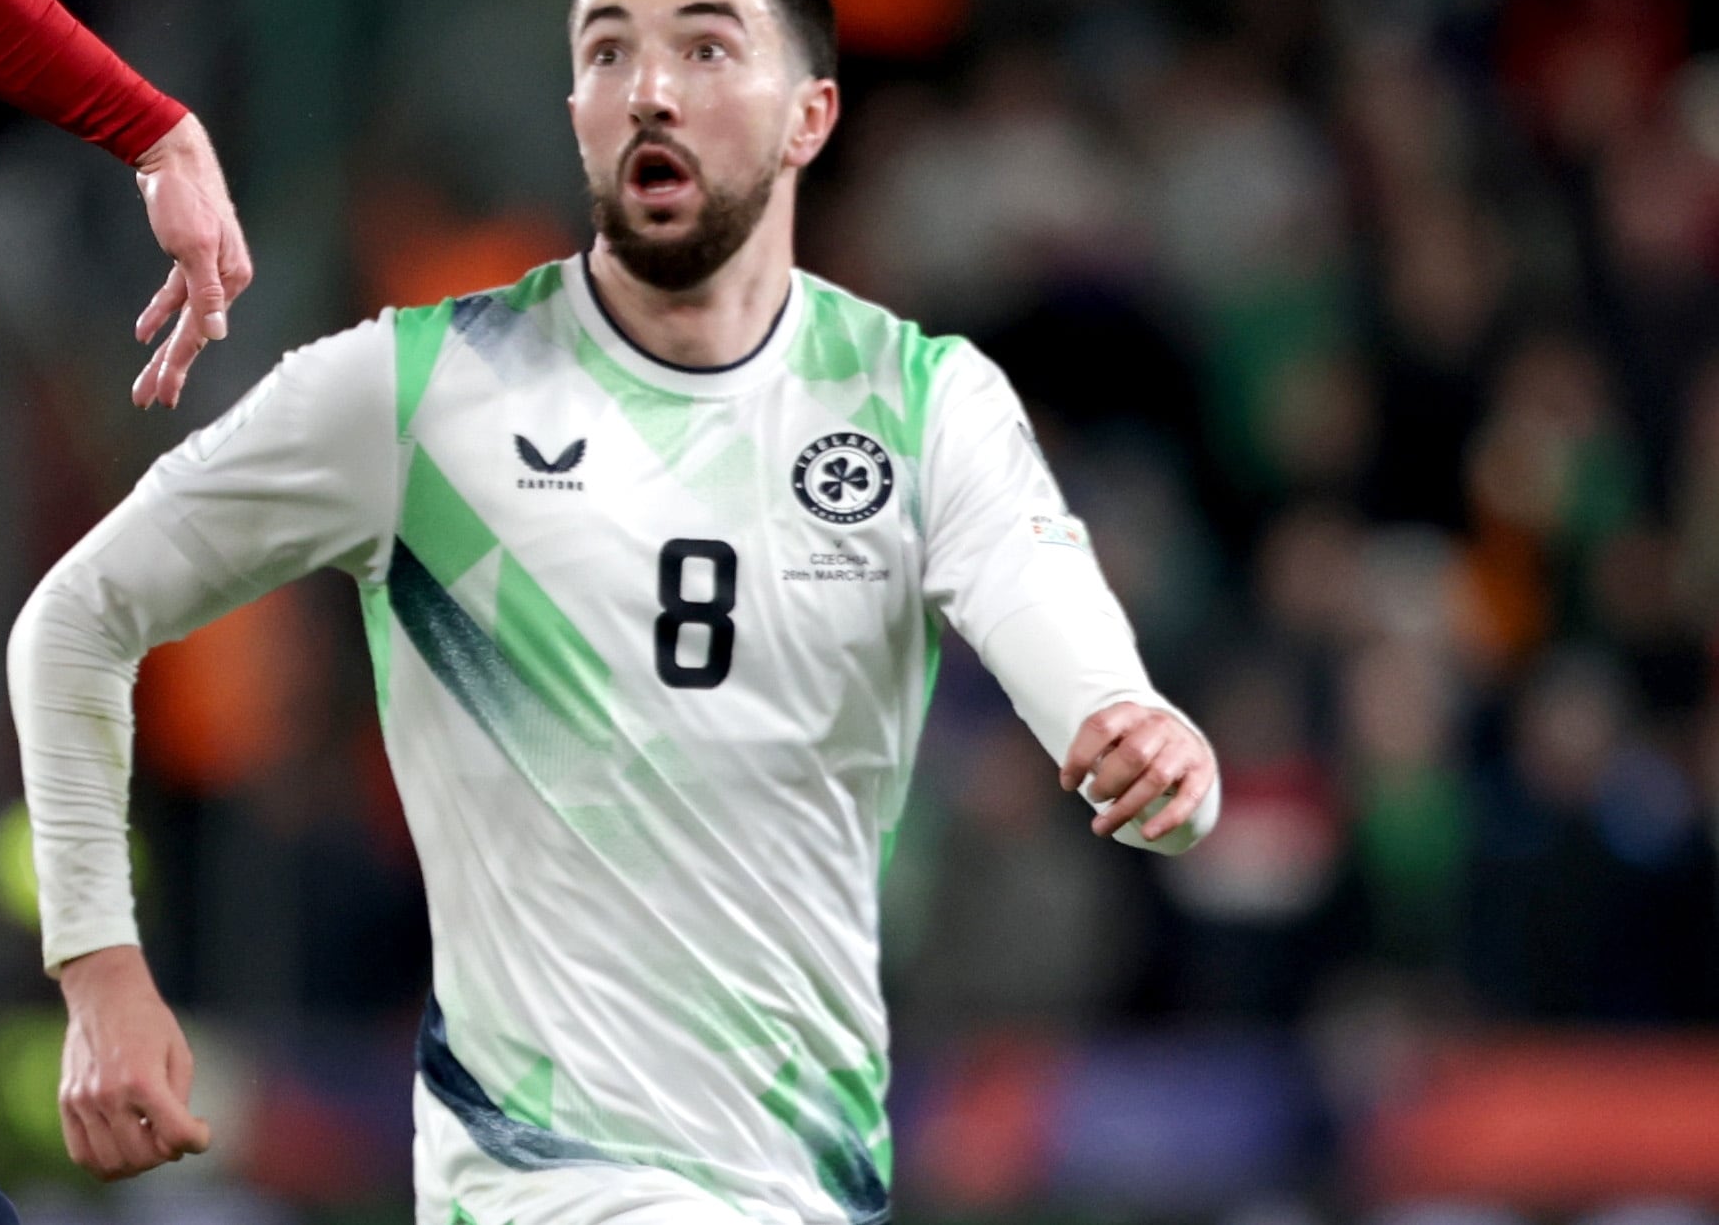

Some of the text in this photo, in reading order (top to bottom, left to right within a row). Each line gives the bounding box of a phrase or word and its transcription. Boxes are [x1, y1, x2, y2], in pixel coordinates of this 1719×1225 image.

[796, 434, 887, 468] IRELAND
[516, 478, 584, 492] CASTORE
[810, 505, 879, 523] FOOTBALL
[654, 538, 737, 689] 8
